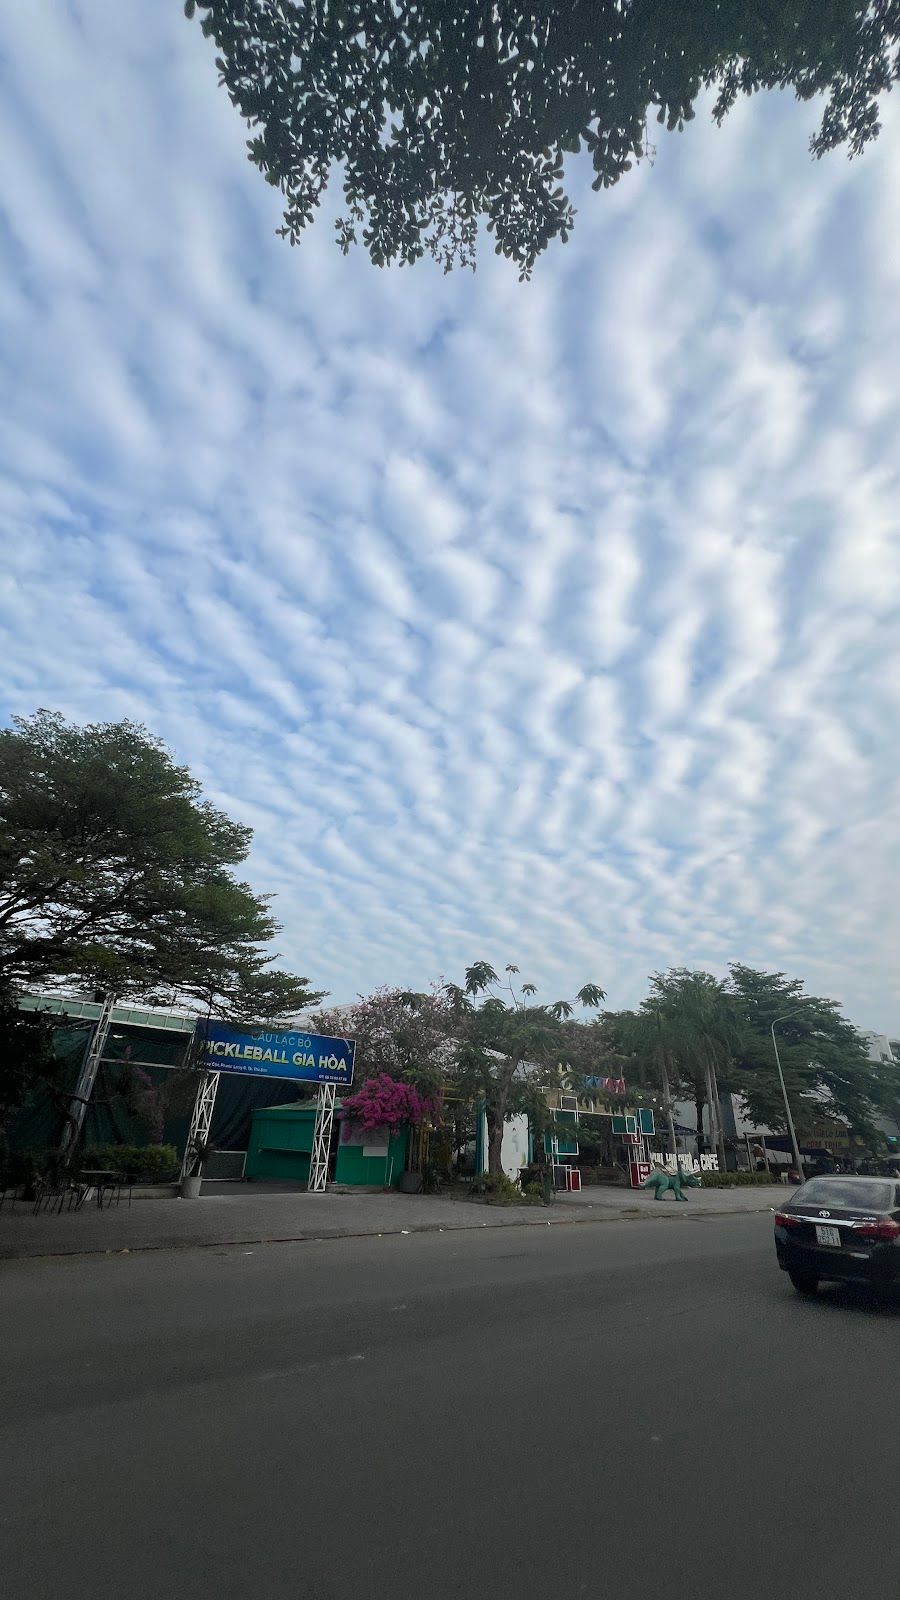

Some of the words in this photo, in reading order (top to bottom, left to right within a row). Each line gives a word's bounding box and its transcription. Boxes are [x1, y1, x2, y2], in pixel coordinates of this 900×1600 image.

[275, 1036, 295, 1048] LẠC
[298, 1037, 311, 1049] BỘ
[200, 1040, 289, 1064] PICKLEBALL
[293, 1053, 315, 1067] GIA
[319, 1052, 347, 1071] HÒA
